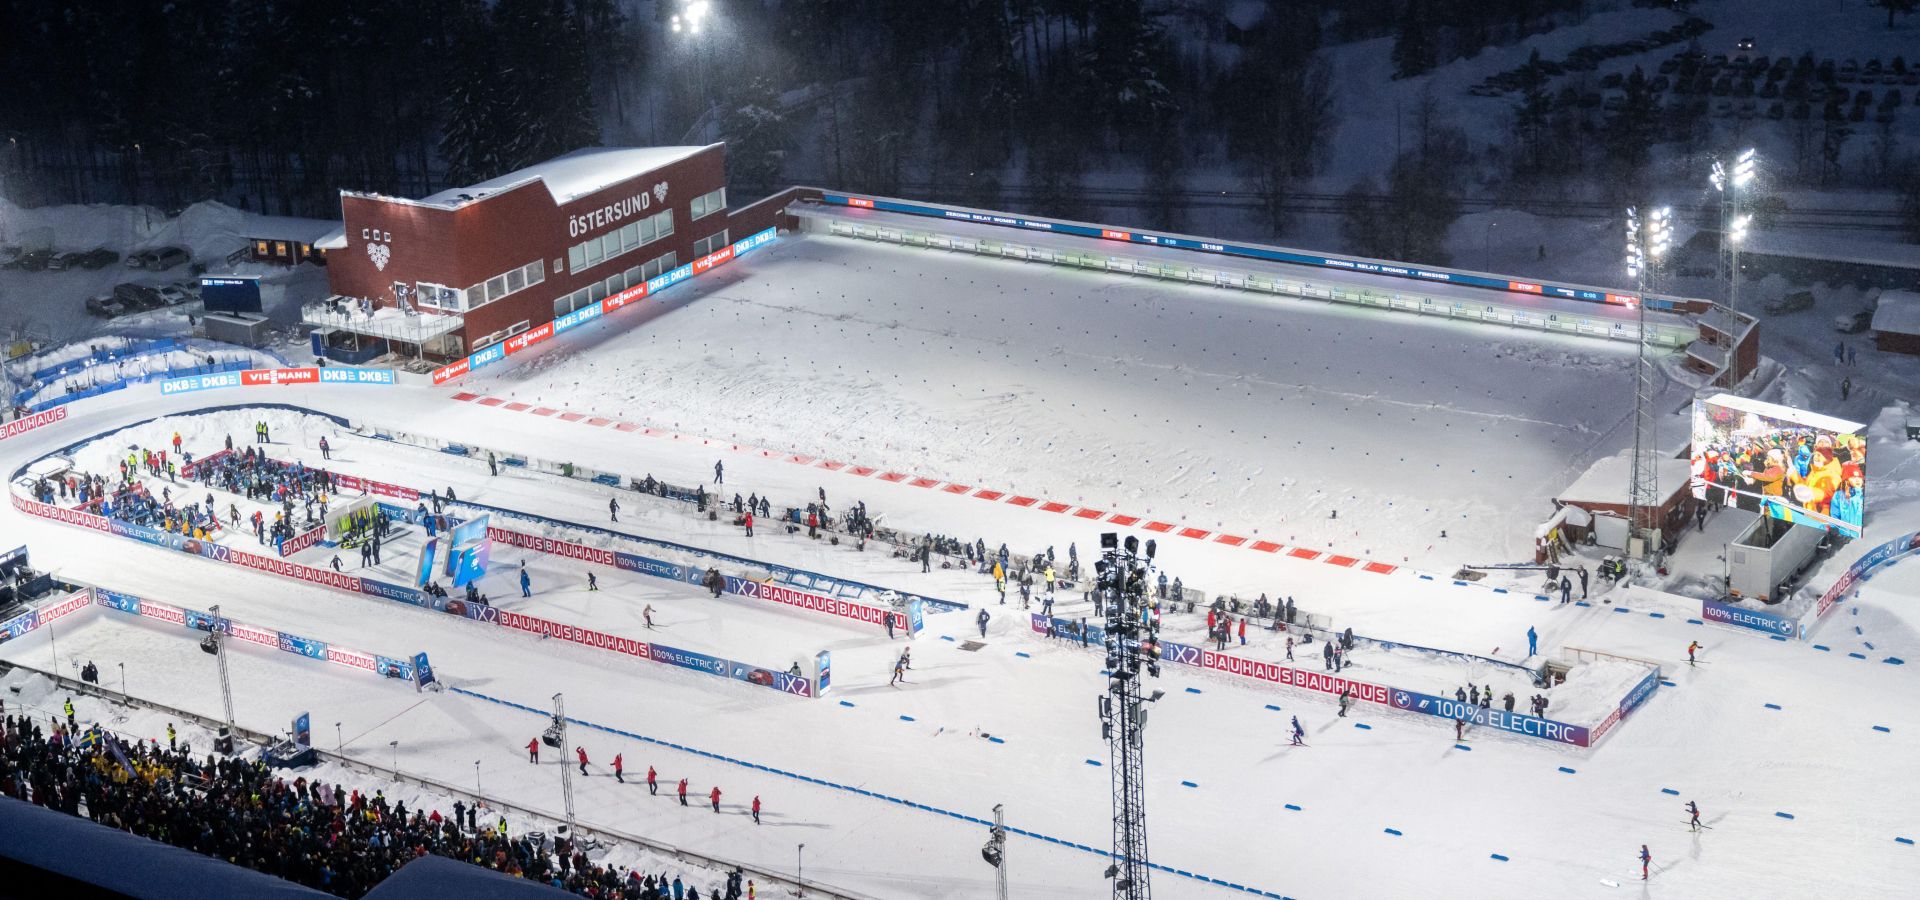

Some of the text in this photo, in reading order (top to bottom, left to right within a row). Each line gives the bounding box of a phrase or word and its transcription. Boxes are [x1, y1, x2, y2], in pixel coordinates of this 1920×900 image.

[570, 191, 650, 238] ÖSTERSUND
[994, 217, 1016, 225] WOMEN
[755, 231, 770, 244] DKB
[736, 241, 750, 254] DKB
[671, 268, 685, 282] DKB
[1357, 263, 1378, 271] RELAY
[1382, 266, 1408, 274] WOMEN
[1418, 271, 1450, 280] FINISHED
[650, 276, 665, 291] DKB
[579, 306, 595, 321] DKB
[556, 316, 572, 331] DKB
[475, 351, 492, 365] DKB
[202, 376, 228, 388] DKB
[249, 369, 312, 385] VIESSMANN
[324, 370, 347, 381] DKB
[359, 371, 382, 382] DKB
[164, 381, 189, 394] DKB
[0, 408, 65, 439] BAUHAUS
[52, 509, 109, 530] BAUHAUS
[111, 523, 157, 541] 100% ELECTRIC
[488, 530, 543, 550] AUHAUS
[207, 543, 230, 562] iX2
[546, 541, 612, 564] BAUHAUS
[232, 551, 293, 576] BAUHAUS
[617, 557, 670, 575] 100% ELECTRIC
[295, 565, 359, 591] BAUHAUS
[363, 583, 415, 602] 100% ELECTRIC
[732, 579, 757, 598] iX2
[97, 598, 119, 609] ELECTRIC
[762, 588, 836, 611] BAUHAUS
[40, 597, 89, 623] BAUHAUS
[141, 605, 184, 623] BAUHAUS
[473, 604, 498, 624] iX2
[840, 604, 904, 629] BAUHU
[1706, 607, 1777, 629] 100% ELECTRIC
[14, 619, 34, 636] iX2
[502, 613, 572, 640] BAUHAUS
[232, 628, 278, 647] BAUHAUS
[575, 628, 647, 656] BAUHAUS
[281, 643, 304, 655] ELECTRIC
[1170, 643, 1199, 666] iX2
[328, 650, 376, 671] BAUHAUS
[653, 648, 712, 670] 100% ELECTRIC
[1204, 653, 1292, 682] BAUHAUS
[781, 674, 808, 696] iX2
[1296, 675, 1387, 702] BAUHAUS
[1435, 700, 1575, 743] 100% ELECTRIC
